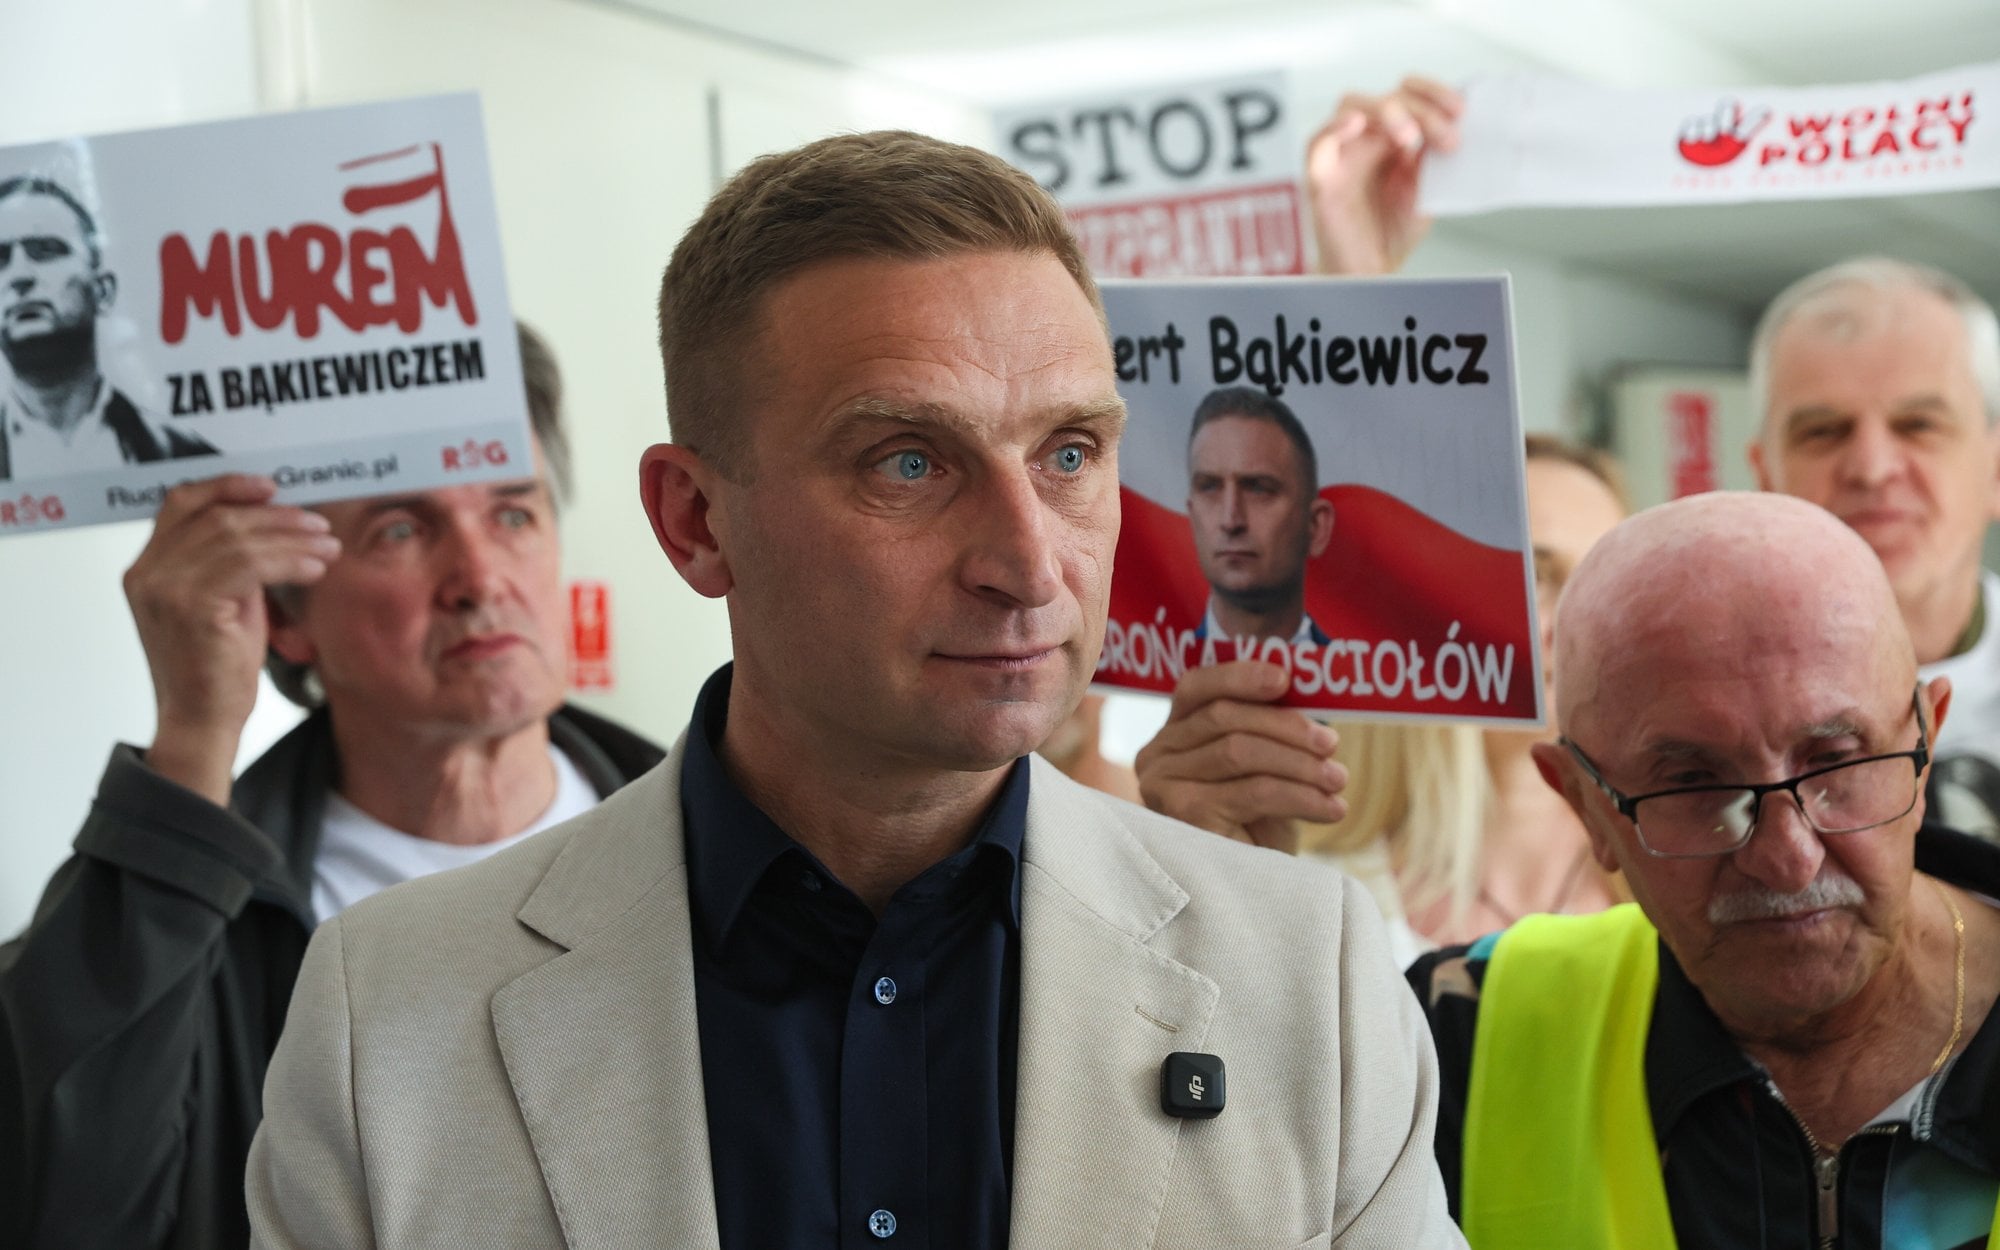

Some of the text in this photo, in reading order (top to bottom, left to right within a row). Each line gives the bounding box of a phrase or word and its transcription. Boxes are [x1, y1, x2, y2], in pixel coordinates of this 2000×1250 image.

[1010, 89, 1282, 192] STOP
[1760, 114, 1974, 166] POLACY
[160, 222, 478, 345] MUREM
[168, 339, 486, 417] ZA BĄKIEWICZEM
[1209, 313, 1490, 396] Bąkiewicz
